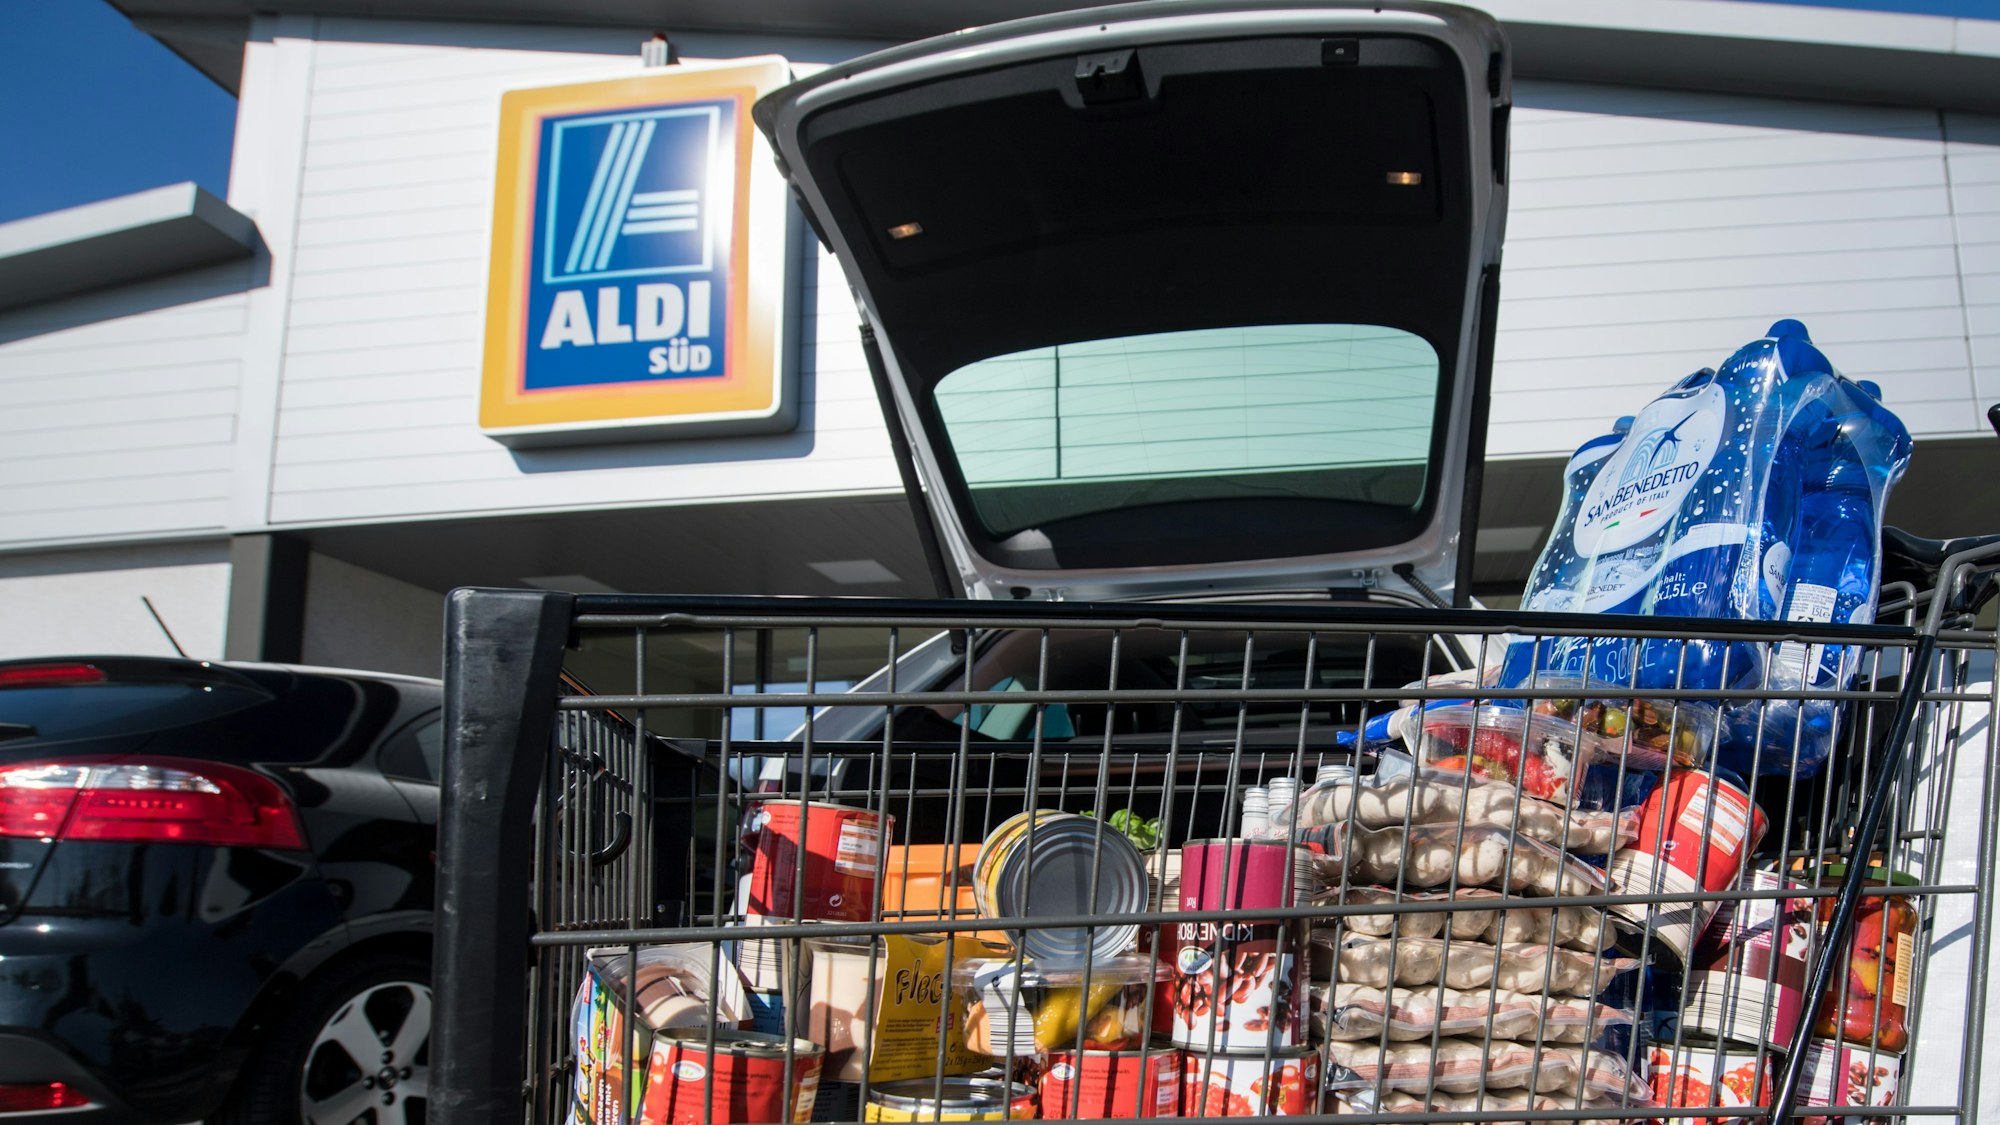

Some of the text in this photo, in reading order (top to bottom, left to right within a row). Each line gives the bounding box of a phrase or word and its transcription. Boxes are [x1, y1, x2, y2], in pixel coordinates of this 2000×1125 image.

[540, 280, 711, 350] ALDI
[648, 337, 712, 374] SÜD
[1600, 490, 1670, 524] PRODUCT OF ITALY
